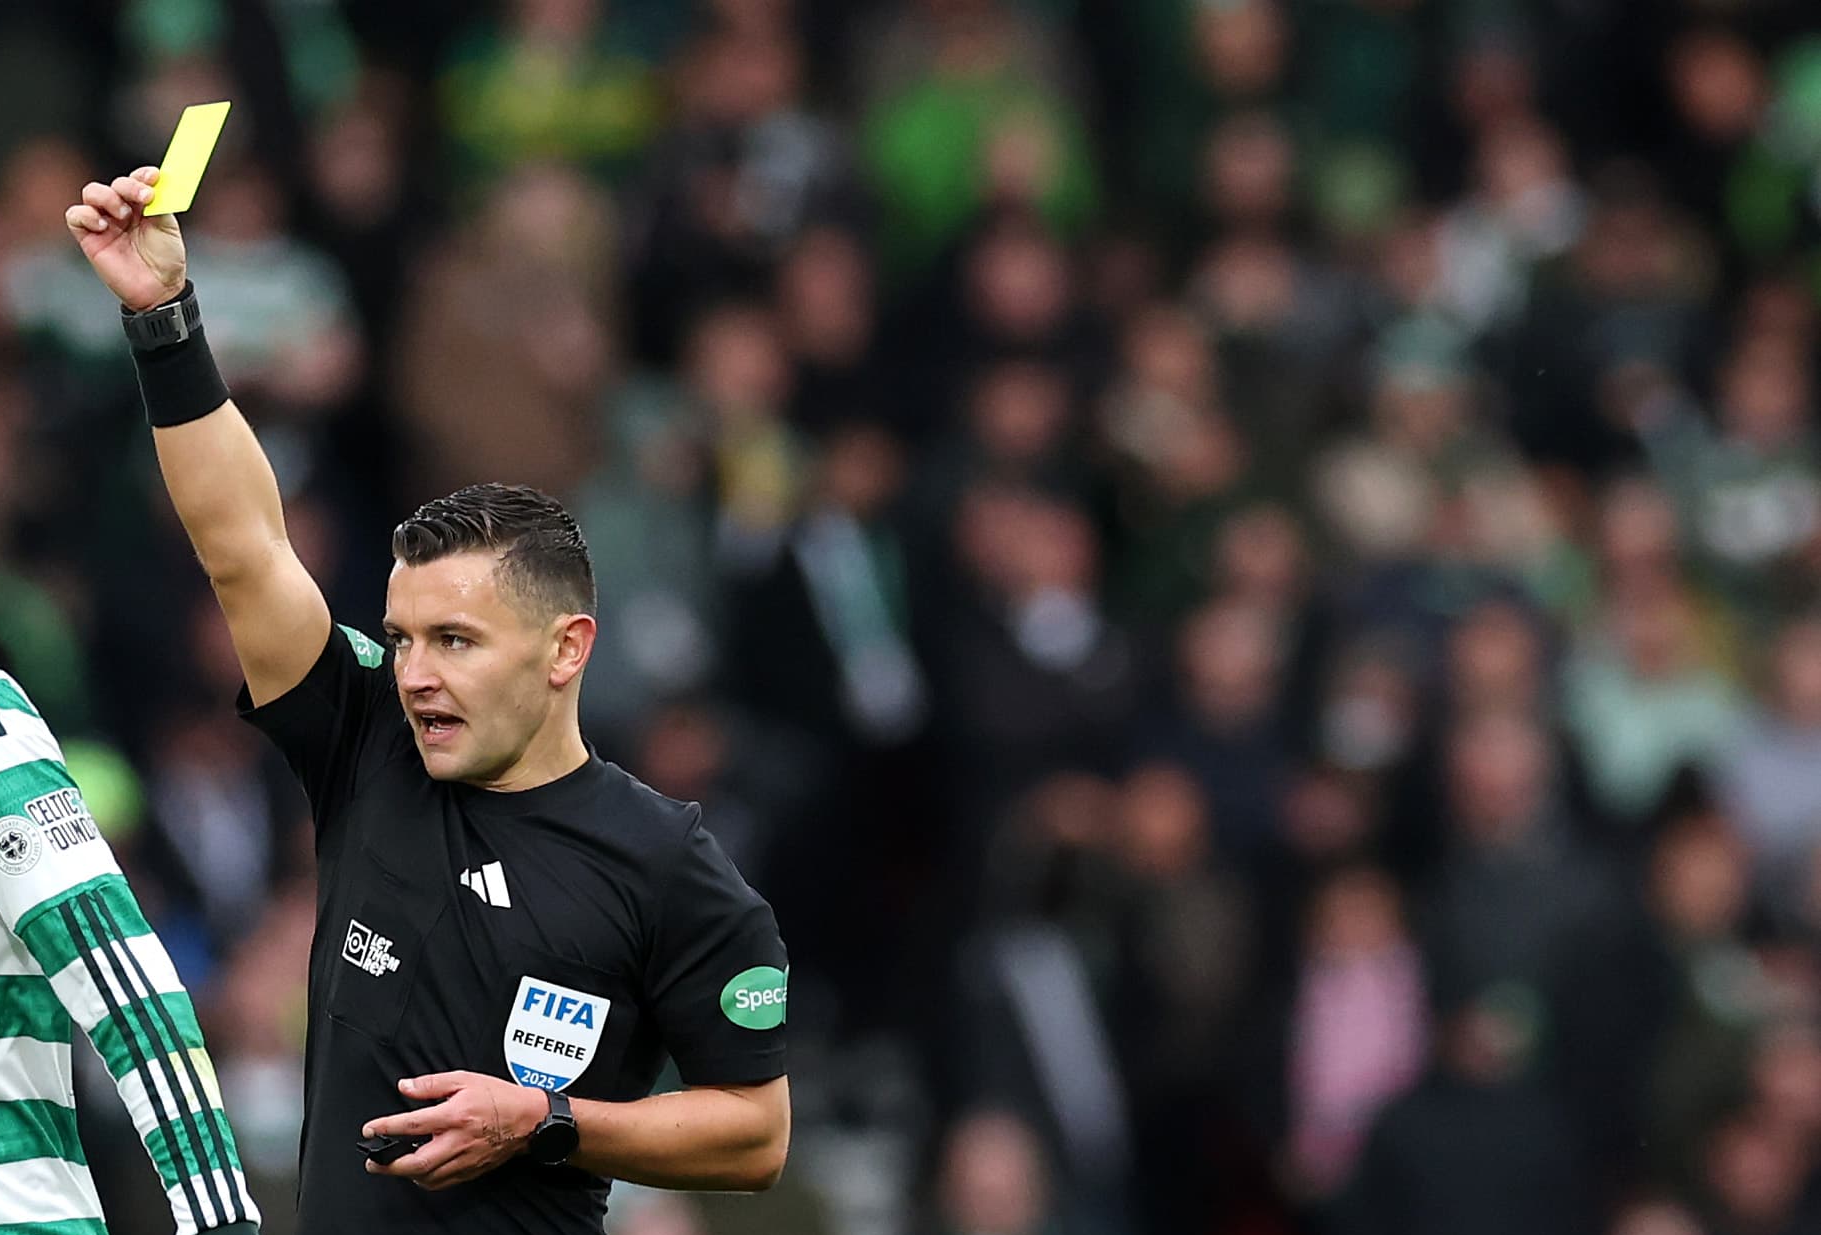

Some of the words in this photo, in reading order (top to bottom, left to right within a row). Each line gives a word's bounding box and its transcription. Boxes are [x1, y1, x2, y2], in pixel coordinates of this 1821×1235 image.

[26, 789, 78, 827] CELTIC
[522, 985, 594, 1030] FIFA
[512, 1029, 587, 1061] REFEREE
[520, 1069, 556, 1089] 2025
